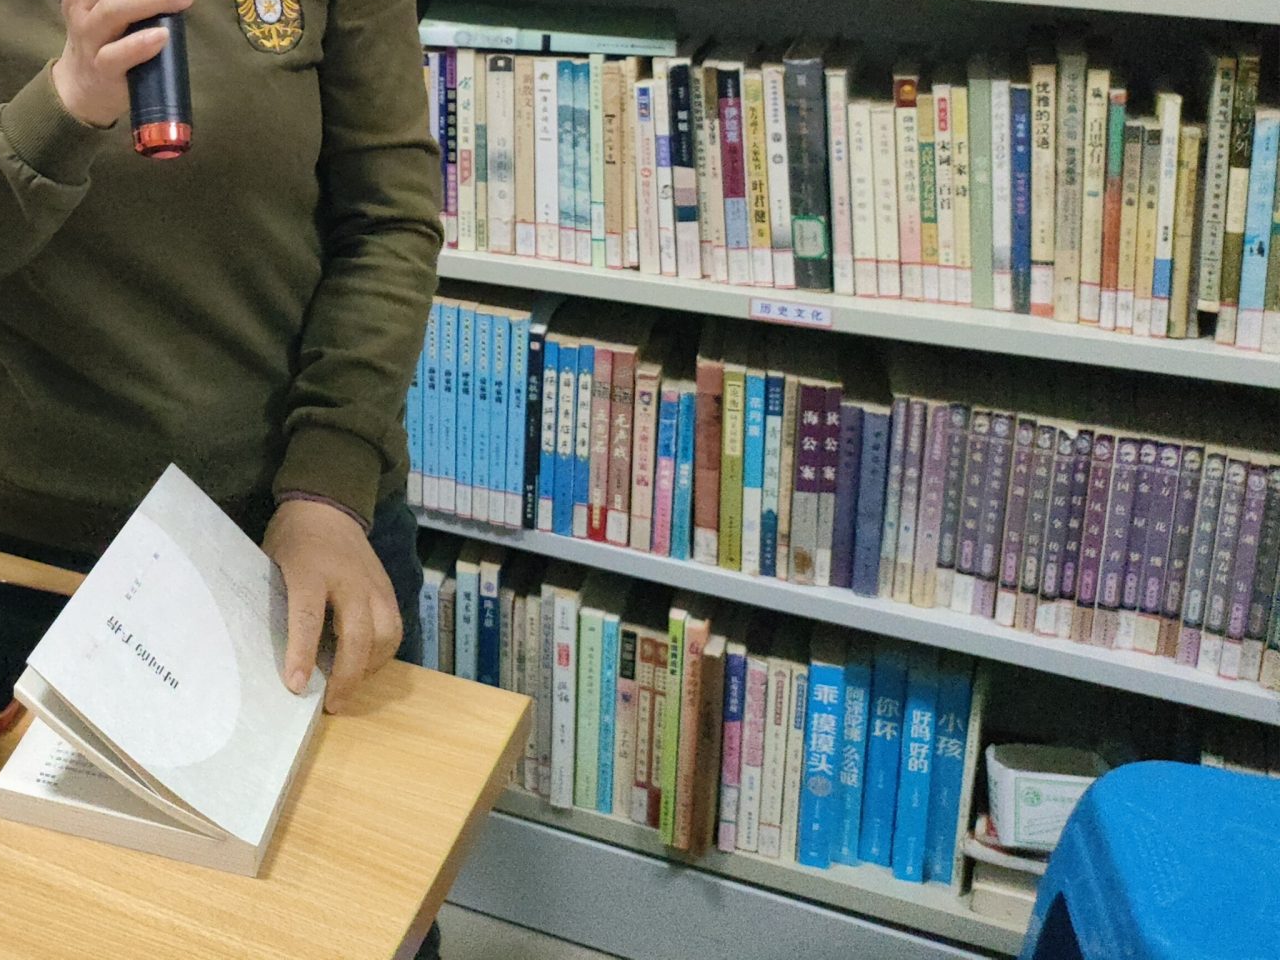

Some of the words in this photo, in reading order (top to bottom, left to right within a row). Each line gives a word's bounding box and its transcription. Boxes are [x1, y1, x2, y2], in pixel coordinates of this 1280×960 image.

[1034, 81, 1051, 150] 优雅的汉语
[760, 304, 825, 321] 历史文化
[800, 410, 819, 481] 海公案
[823, 411, 840, 481] 狄公案
[872, 695, 902, 742] 你坏
[906, 708, 933, 775] 好吗好的
[934, 711, 965, 762] 小孩
